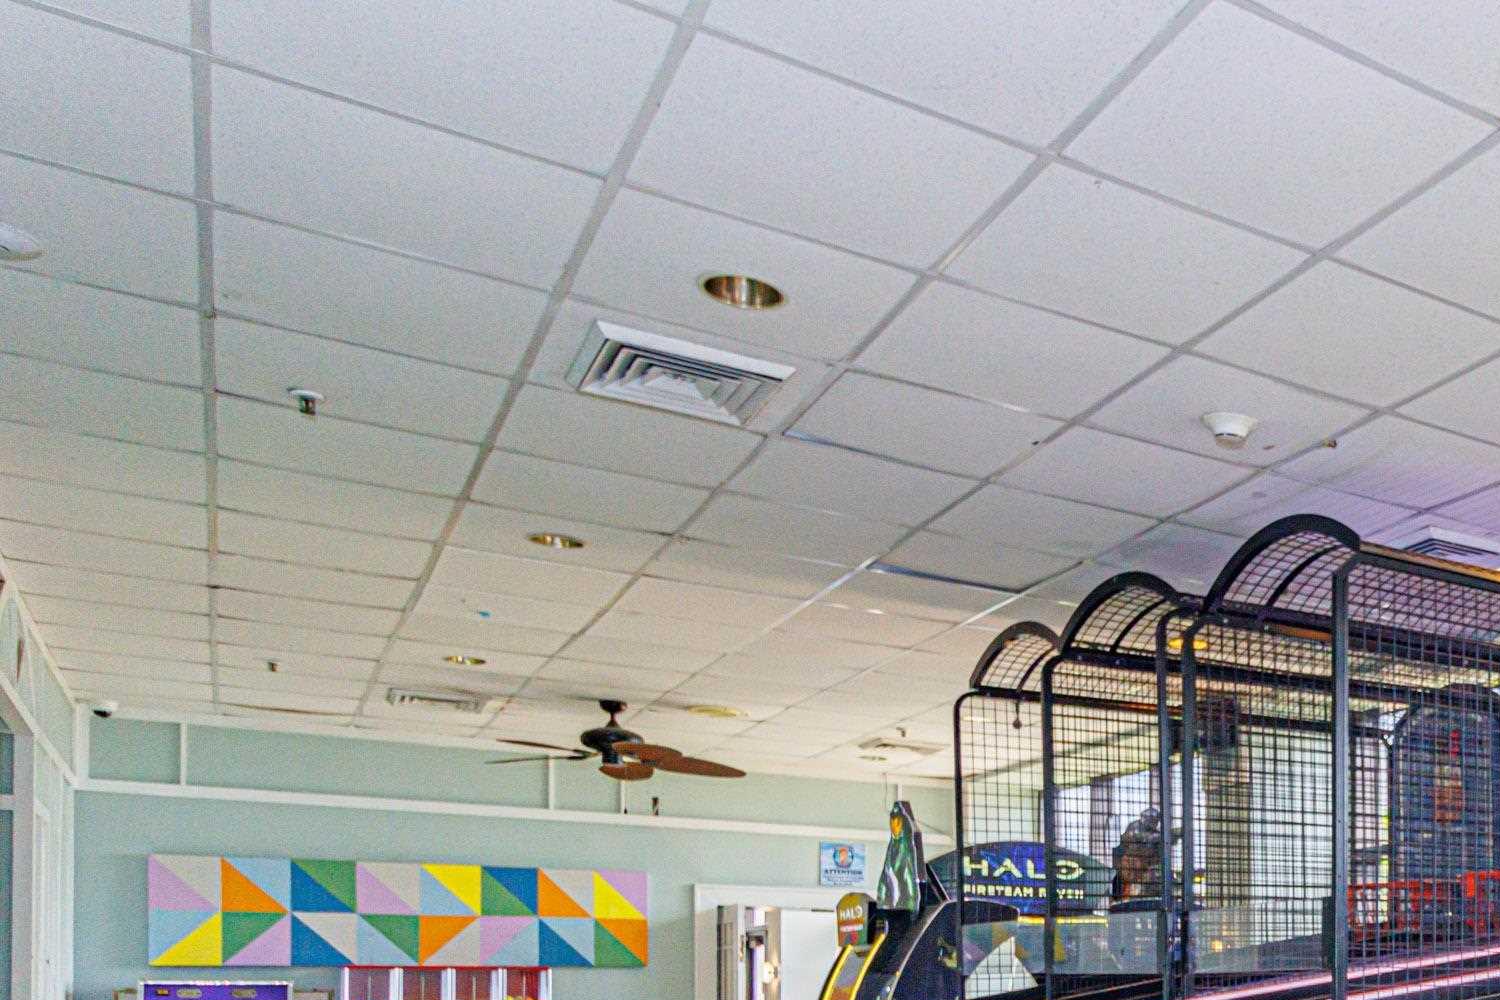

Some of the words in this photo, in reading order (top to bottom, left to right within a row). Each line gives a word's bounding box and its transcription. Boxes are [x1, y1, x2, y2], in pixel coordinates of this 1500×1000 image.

[963, 856, 1085, 881] HALO
[963, 884, 1033, 897] FIRETEAM
[1034, 886, 1084, 900] RVEN
